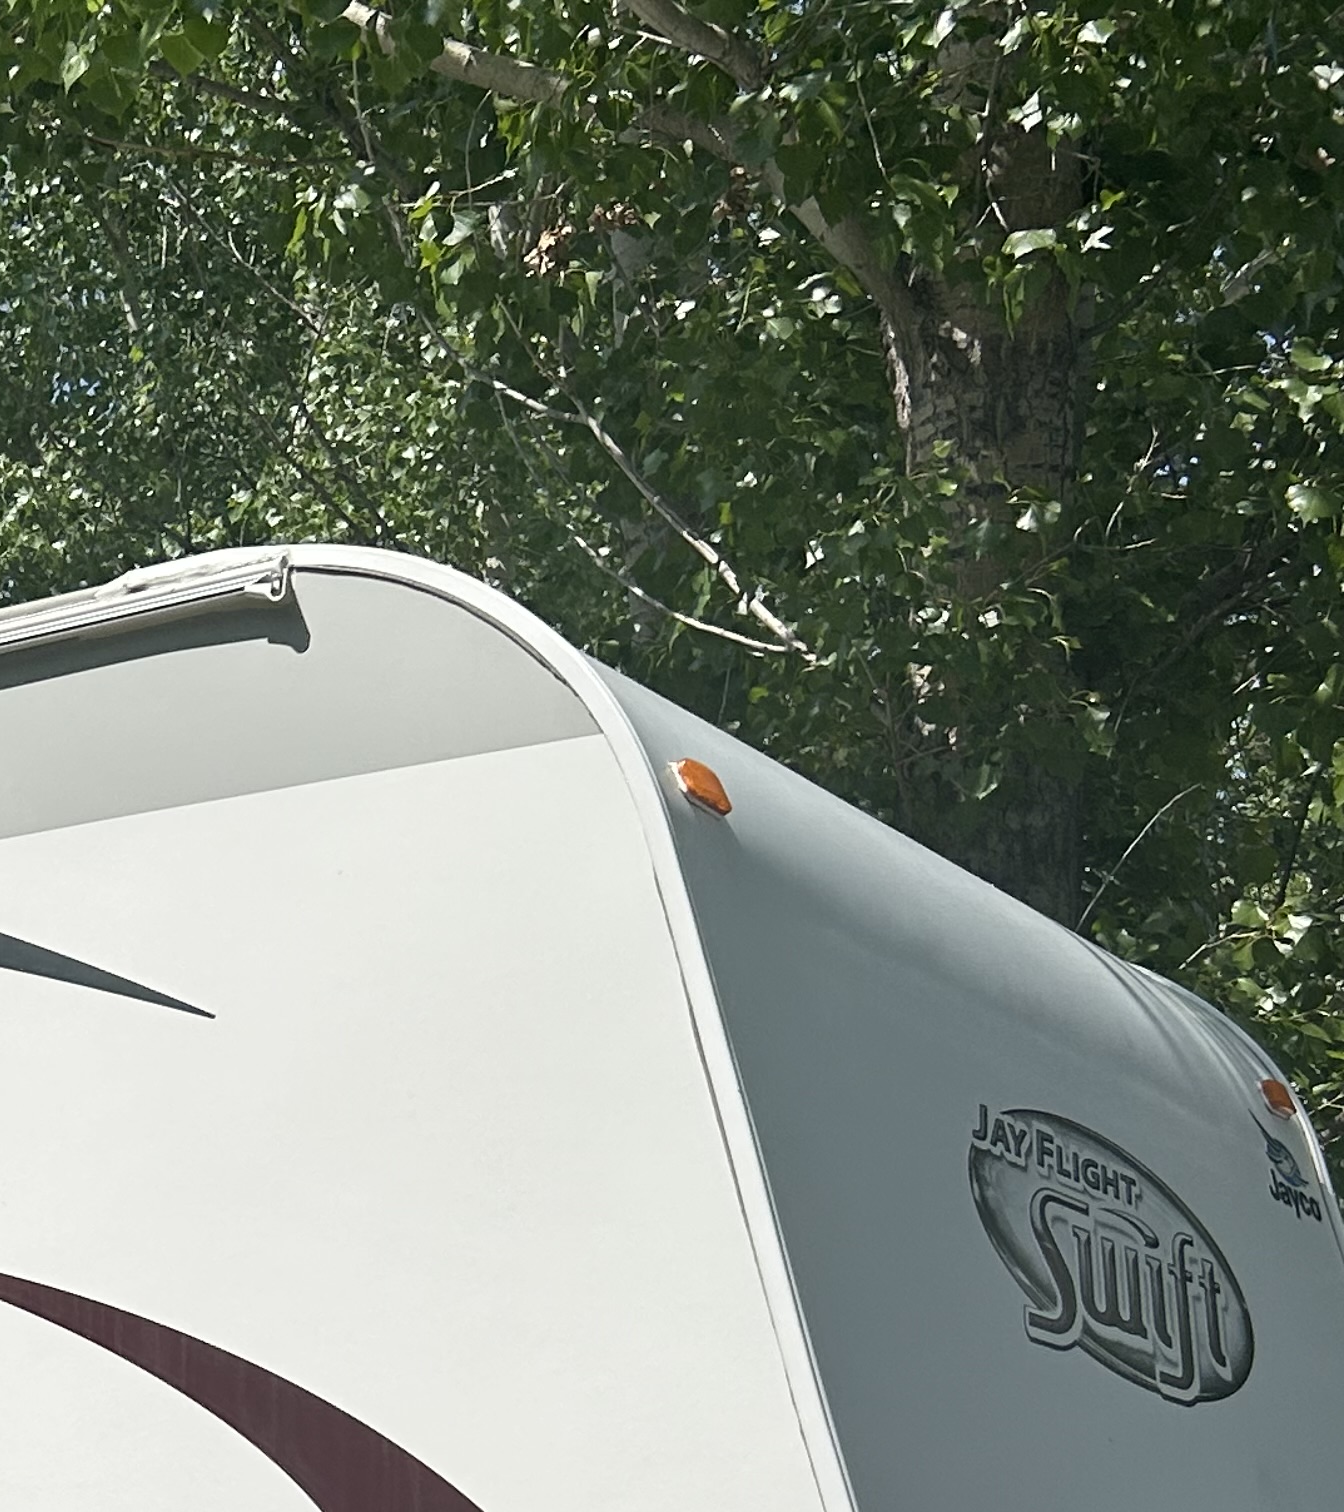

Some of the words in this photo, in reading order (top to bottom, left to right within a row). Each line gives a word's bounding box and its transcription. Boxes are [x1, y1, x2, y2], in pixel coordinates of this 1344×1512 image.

[971, 1103, 1031, 1160] JAY
[1035, 1129, 1137, 1206] FLIGHT
[1268, 1168, 1322, 1222] Jayco
[1026, 1190, 1228, 1392] Swift
